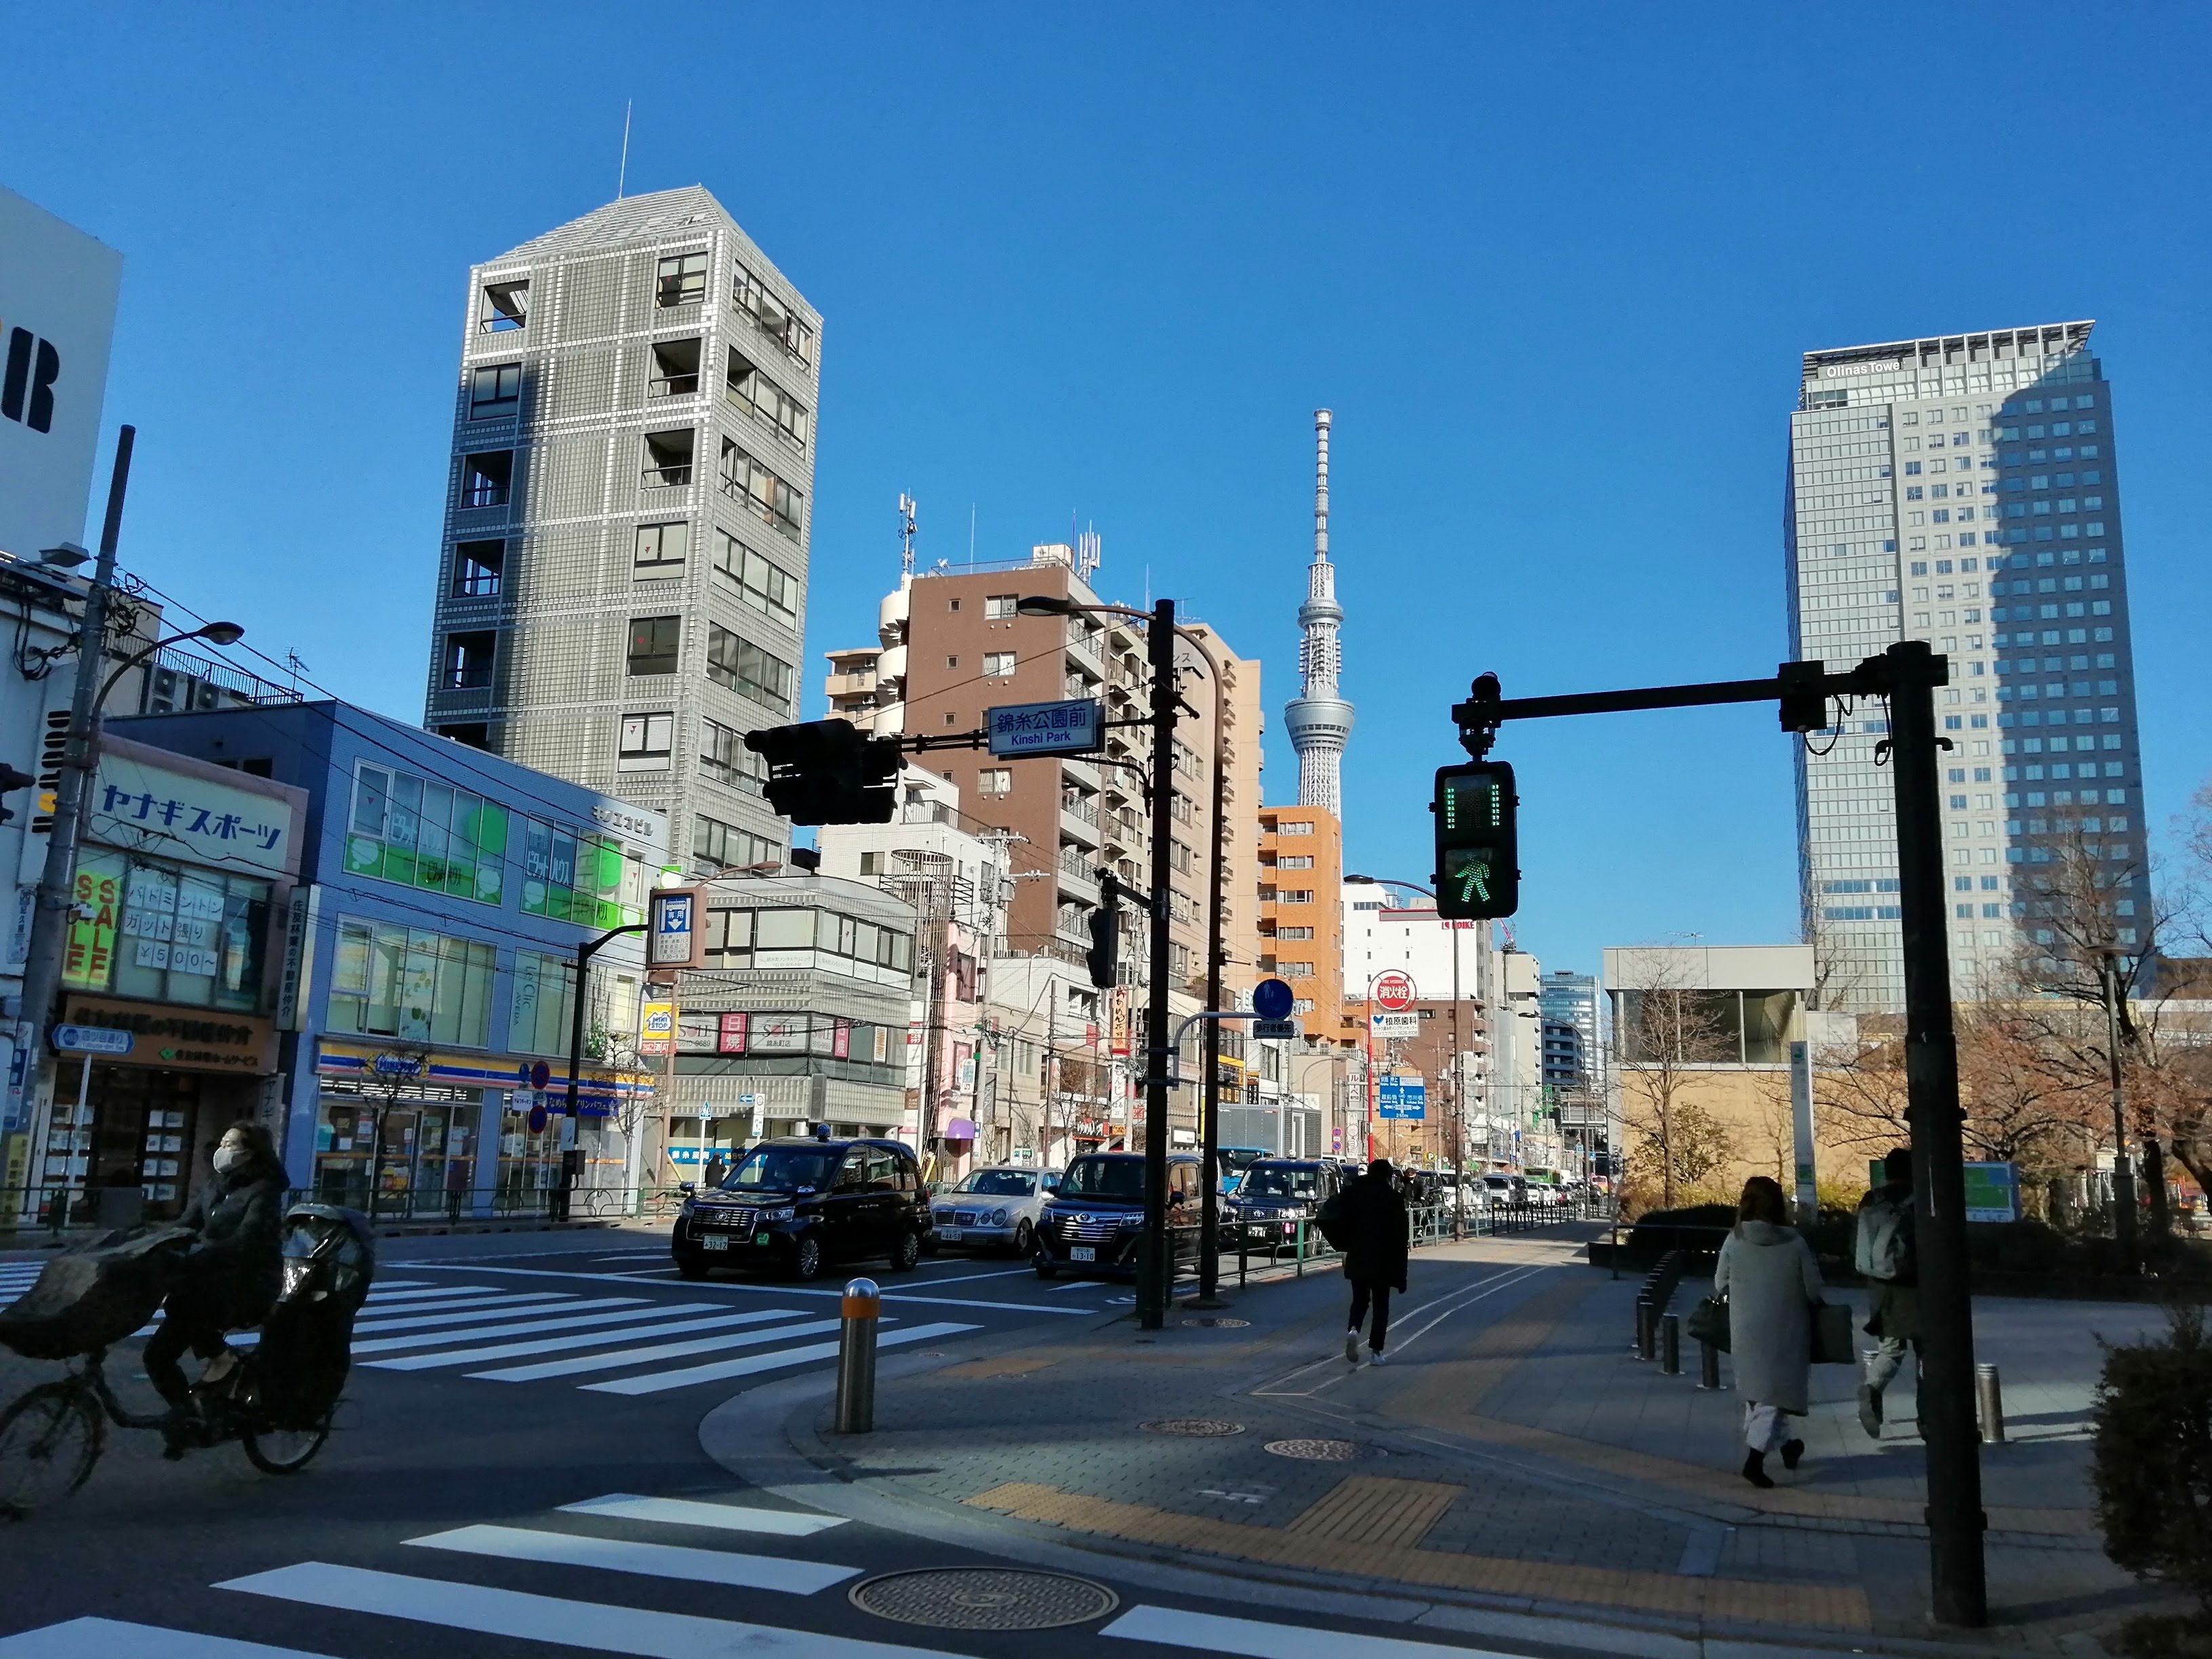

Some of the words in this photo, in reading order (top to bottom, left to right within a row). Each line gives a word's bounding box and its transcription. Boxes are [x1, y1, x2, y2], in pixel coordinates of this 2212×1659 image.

[1826, 365, 1868, 377] Olinas
[997, 706, 1086, 733] 錦糸公園前
[1011, 733, 1043, 745] Kinshi
[1047, 731, 1071, 742] Park
[103, 784, 281, 850] ヤナギスポーツ
[128, 886, 222, 914] バドミントン
[66, 874, 93, 977] SLE
[89, 879, 115, 980] SALE
[125, 914, 203, 939] ガット張り
[1380, 985, 1408, 999] 消火栓
[726, 1017, 741, 1049] 日焼
[1255, 1023, 1292, 1033] 歩行者優先
[549, 1097, 610, 1111] なめらプリンパフェ
[708, 1241, 727, 1250] 32-12
[1076, 1252, 1094, 1261] 13-10
